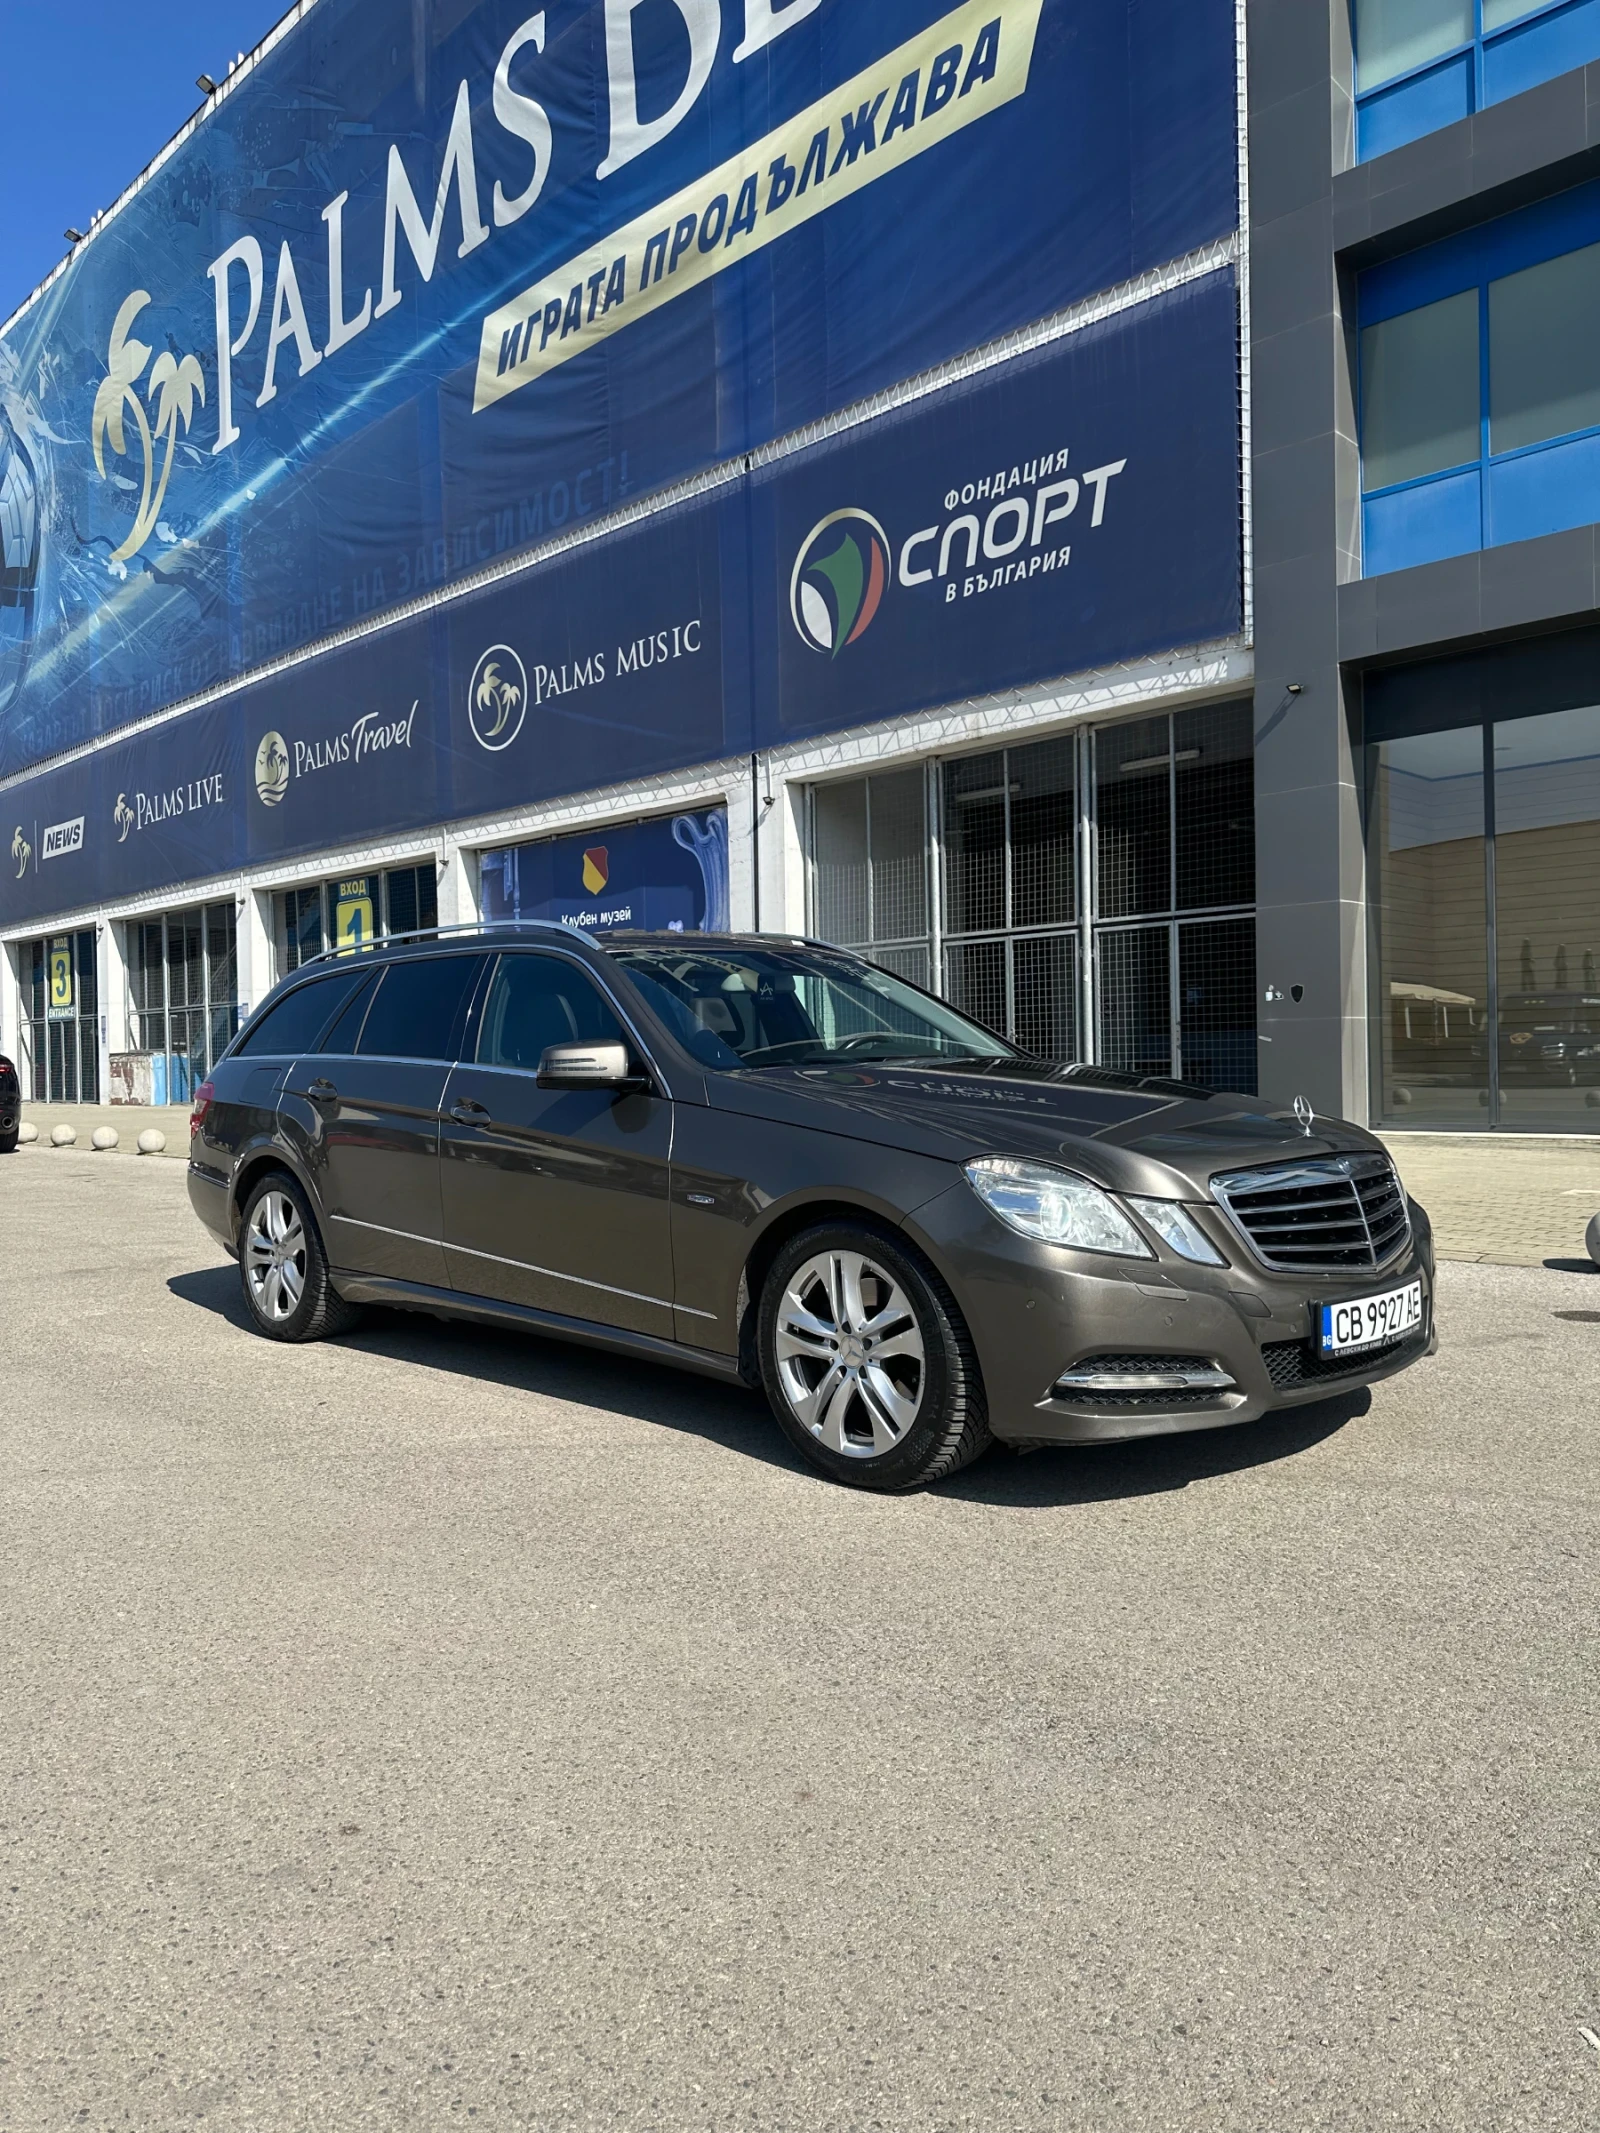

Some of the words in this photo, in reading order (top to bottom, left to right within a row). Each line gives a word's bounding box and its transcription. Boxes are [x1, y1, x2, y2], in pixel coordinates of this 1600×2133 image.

[497, 254, 627, 377] ИГРАТА
[639, 15, 1003, 292] ПРОДЪЛЖАВА
[207, 10, 553, 455] PALMS
[597, 0, 824, 180] D
[944, 448, 1069, 510] ФОНДАЦИЯ
[353, 567, 387, 613] НА
[398, 450, 632, 595] ЗАВИСИМОСТ!
[898, 458, 1128, 587] СПОРТ
[946, 583, 957, 603] В
[963, 546, 1071, 597] БЪЛГАРИЯ
[533, 652, 605, 705] PALMS
[616, 620, 701, 677] MUSIC
[293, 733, 350, 778] PALMS
[351, 699, 419, 763] Travel
[135, 786, 184, 830] PALMS
[187, 773, 223, 811] LIVE
[46, 824, 81, 852] NEWS
[340, 880, 366, 896] ВХОД
[347, 908, 363, 954] 1
[561, 911, 598, 928] Клубен
[600, 906, 632, 926] музей
[56, 959, 67, 998] 3
[49, 1006, 75, 1018] ENTRANCE
[1336, 1306, 1363, 1343] CB
[1367, 1293, 1404, 1337] 9927
[1406, 1286, 1420, 1323] AE
